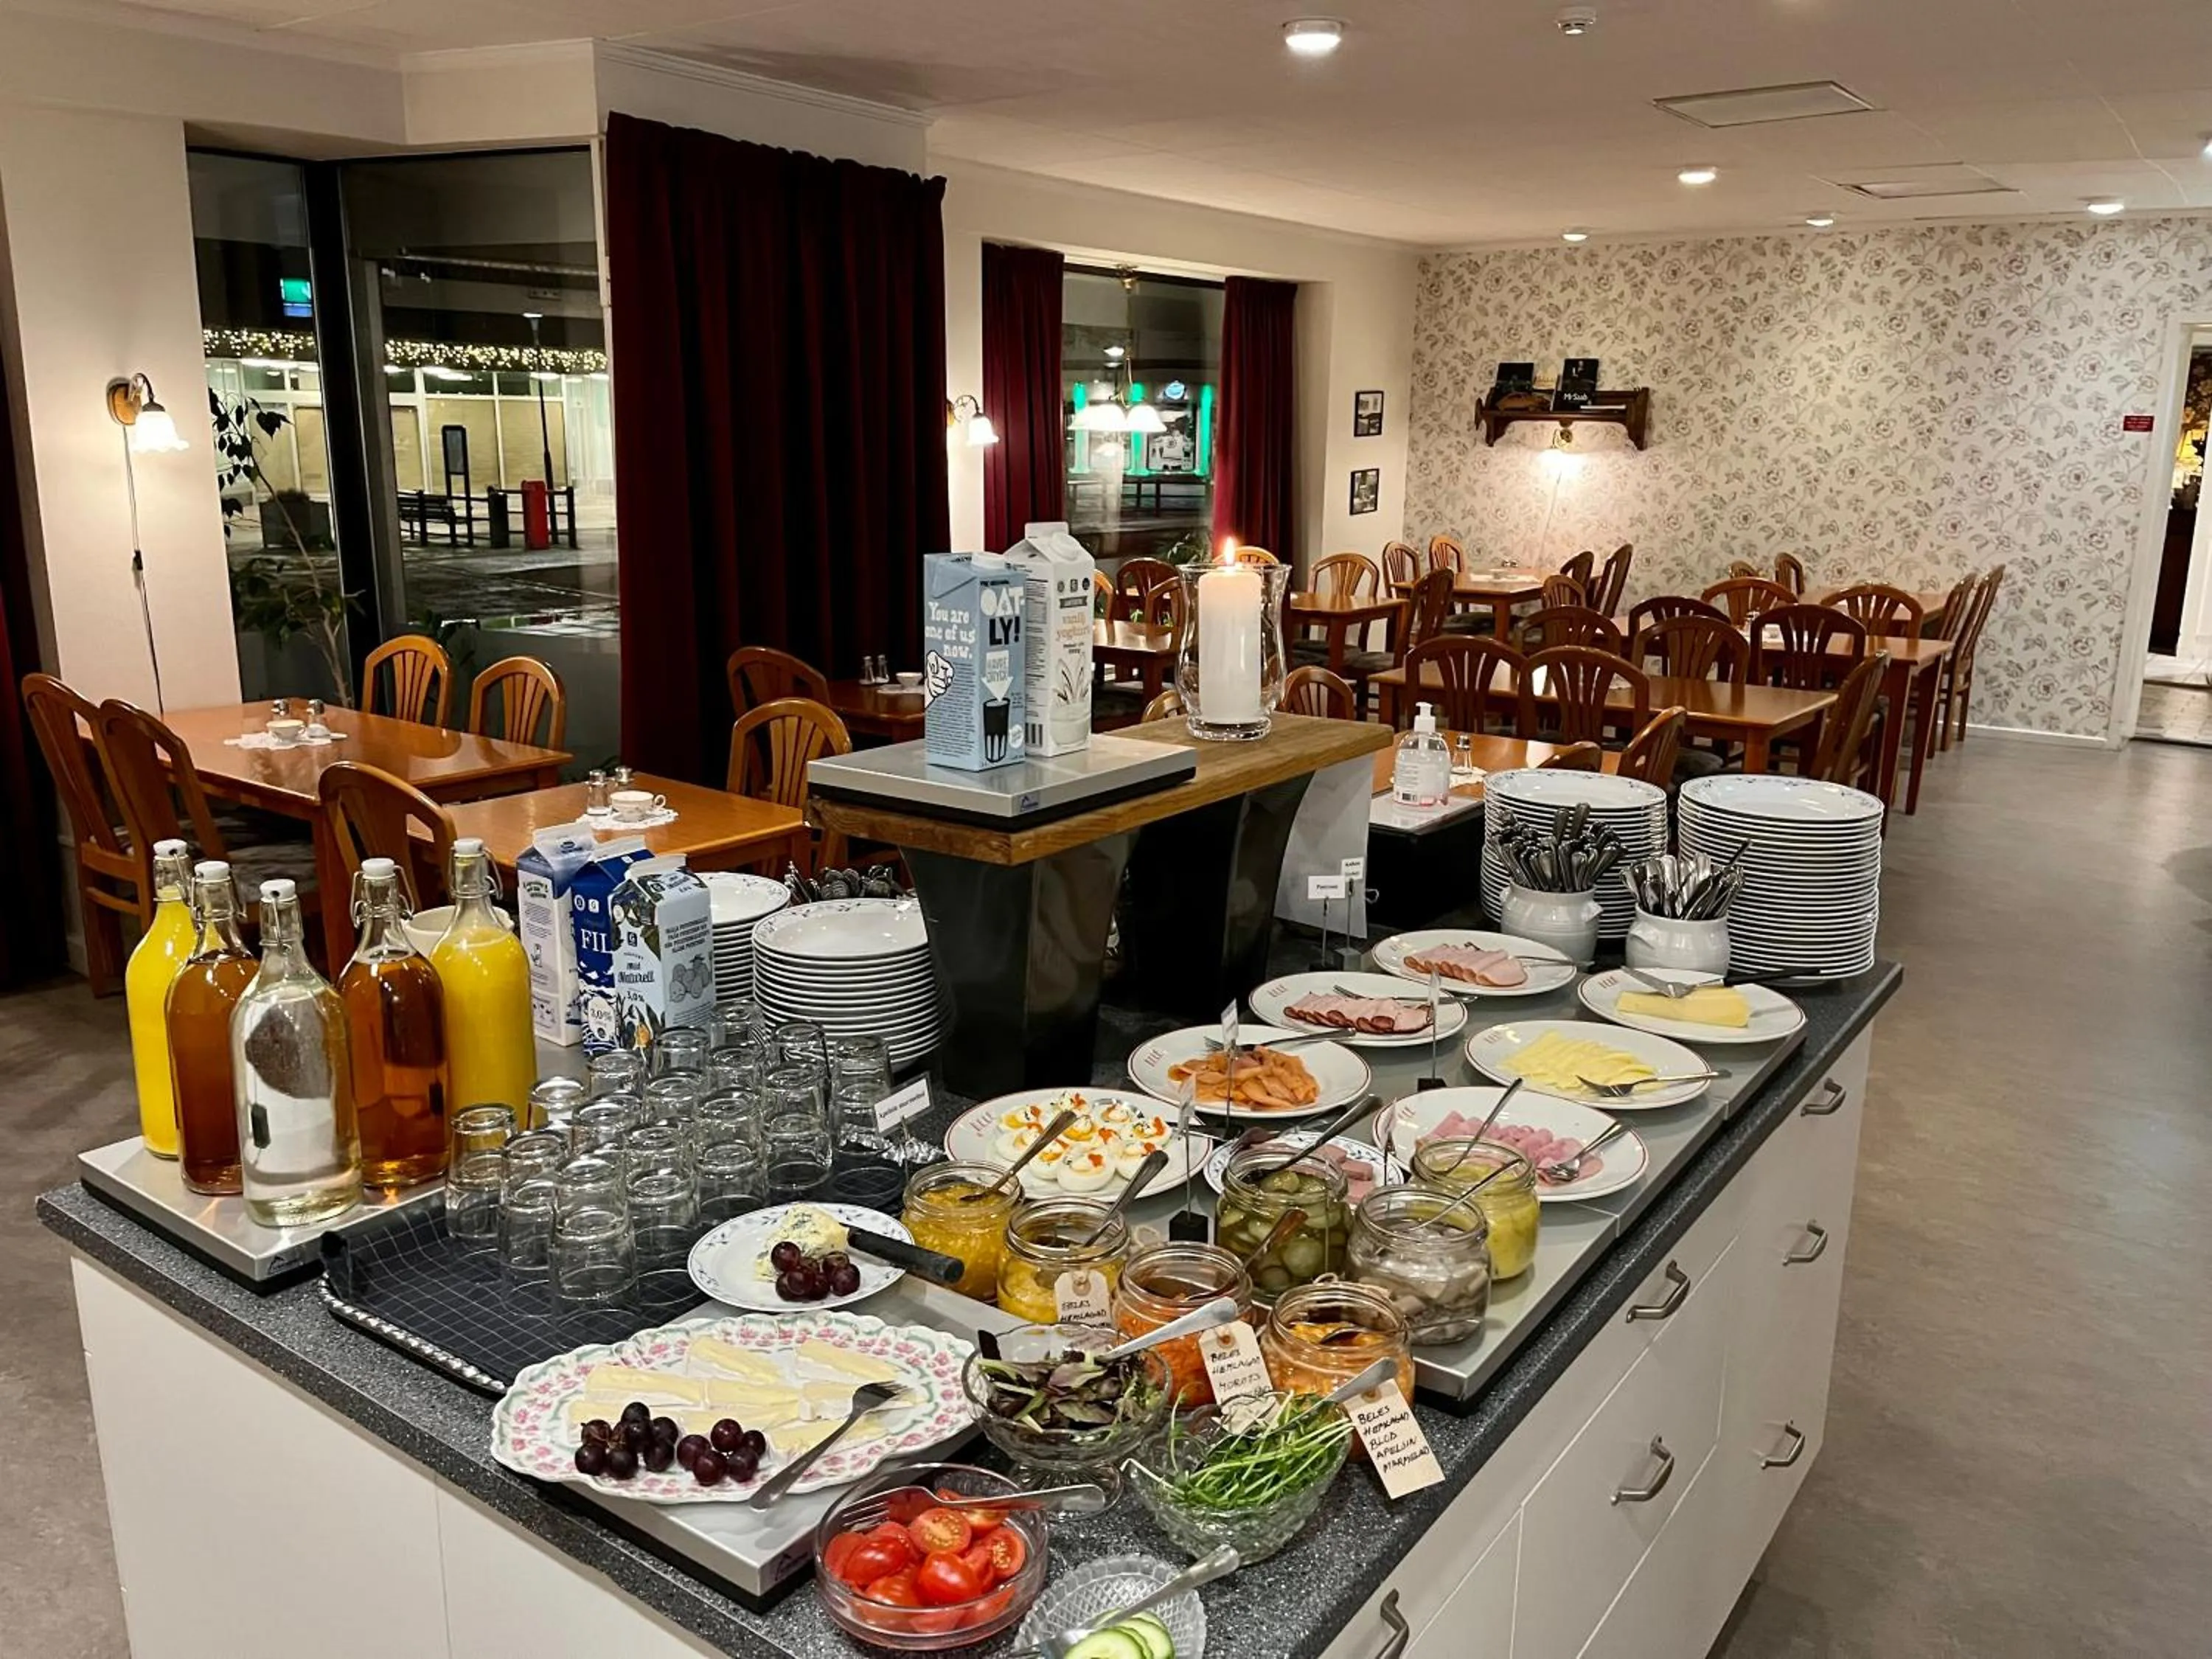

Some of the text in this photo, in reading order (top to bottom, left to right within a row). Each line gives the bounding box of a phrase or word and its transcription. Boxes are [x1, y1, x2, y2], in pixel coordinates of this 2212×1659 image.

[928, 601, 970, 625] You are
[925, 623, 976, 644] one of us
[989, 616, 1020, 646] LY!
[943, 643, 973, 660] now.
[580, 928, 613, 954] FIL
[1357, 1405, 1390, 1425] BELES
